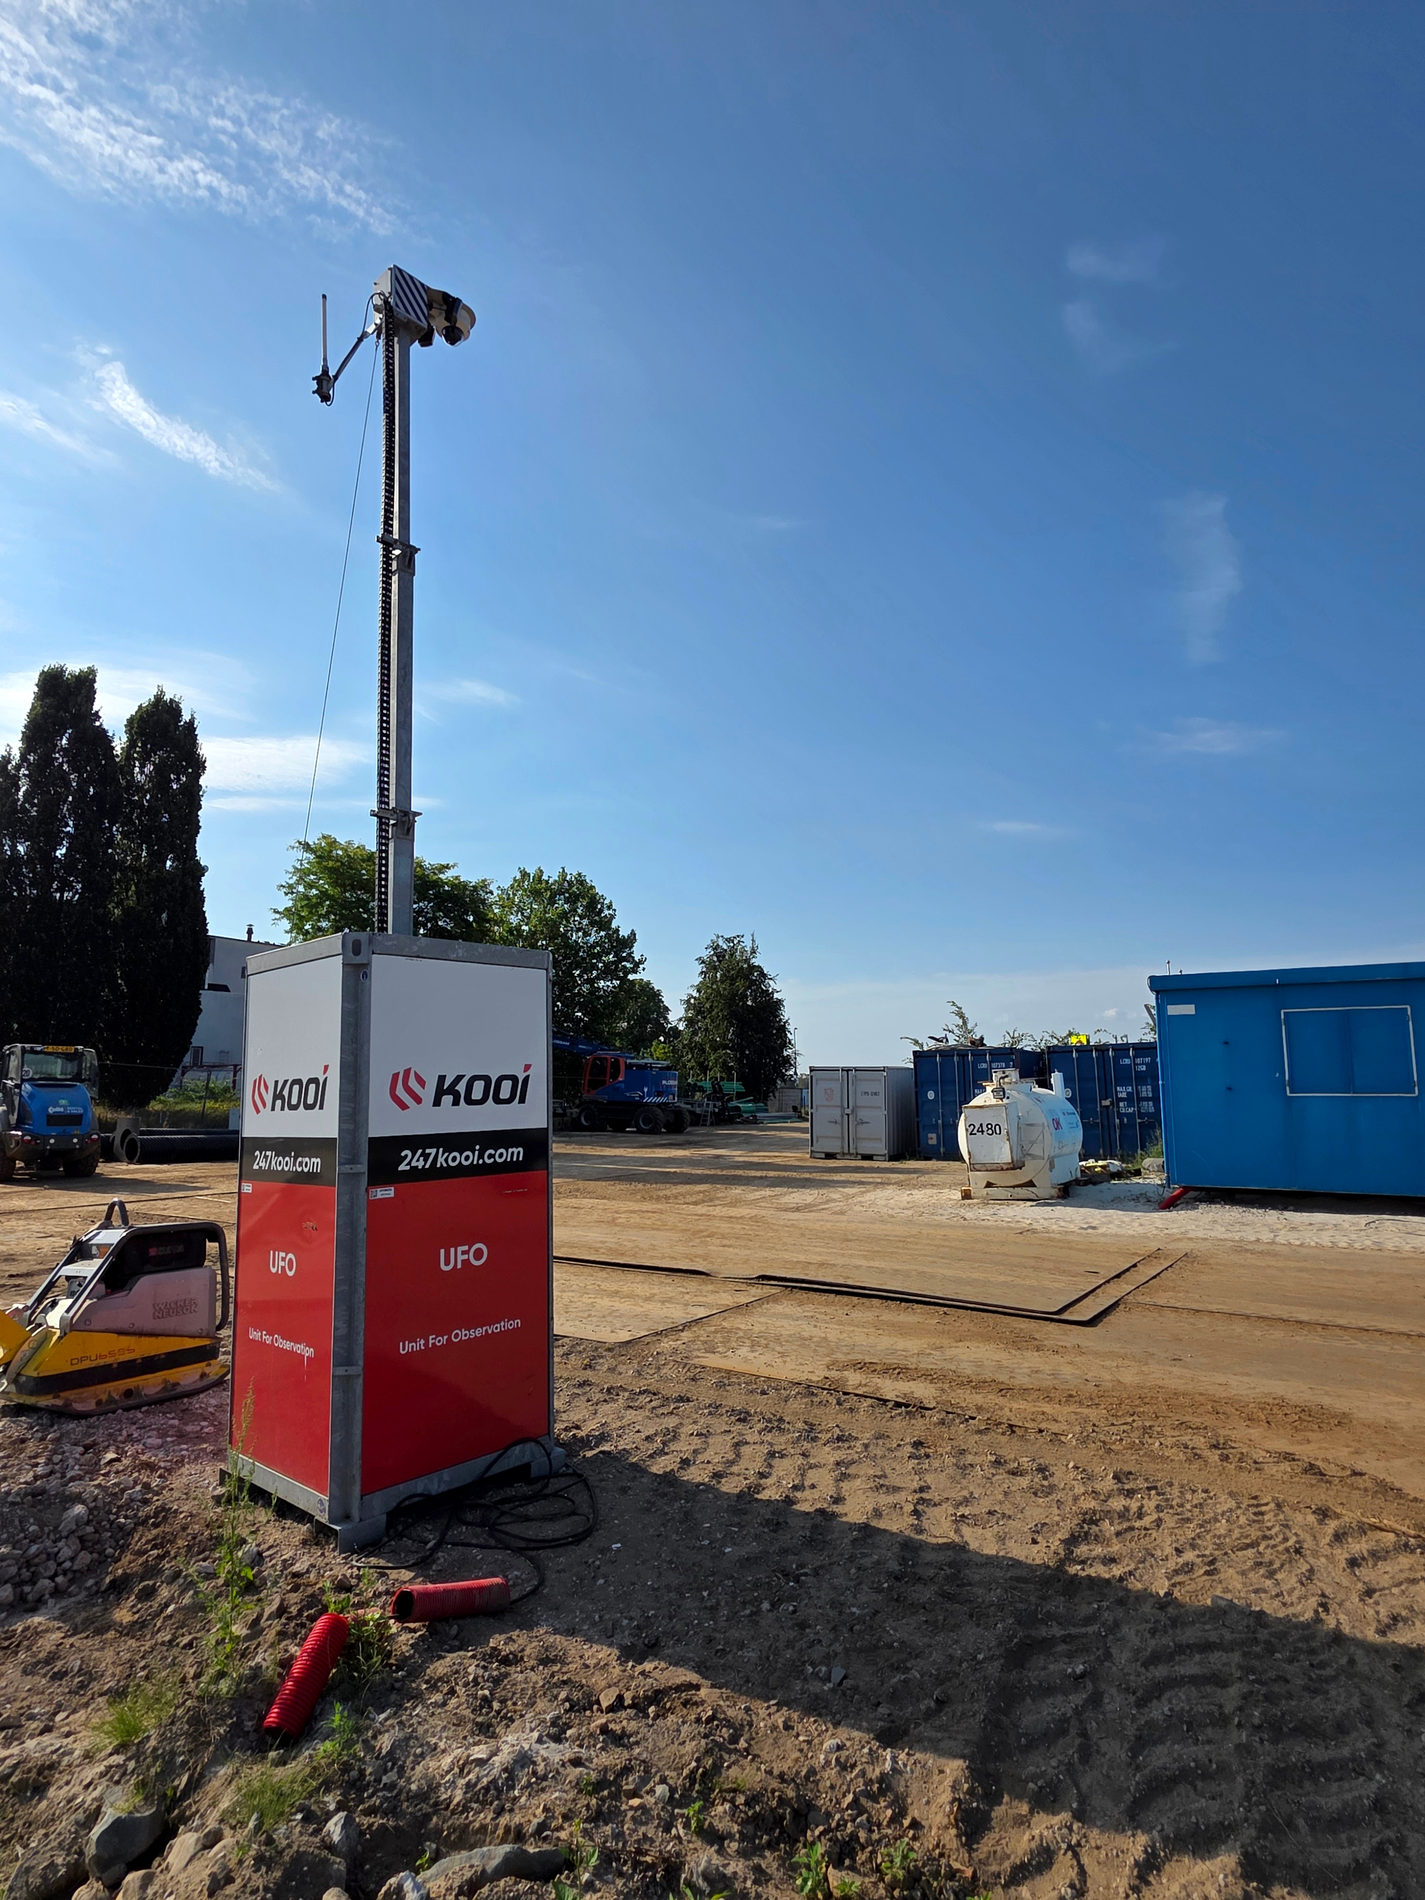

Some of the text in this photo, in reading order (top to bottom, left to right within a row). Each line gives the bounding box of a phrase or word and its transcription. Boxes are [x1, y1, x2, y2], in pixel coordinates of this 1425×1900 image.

[967, 1122, 1002, 1136] 2480
[252, 1150, 322, 1173] 247kooi.com
[397, 1144, 525, 1171] 247kooi.com
[269, 1249, 297, 1277] UFO
[439, 1242, 489, 1272] UFO
[151, 1306, 199, 1321] NEUSON
[248, 1326, 315, 1358] Unit For Observation
[399, 1318, 522, 1355] Unit For Observation
